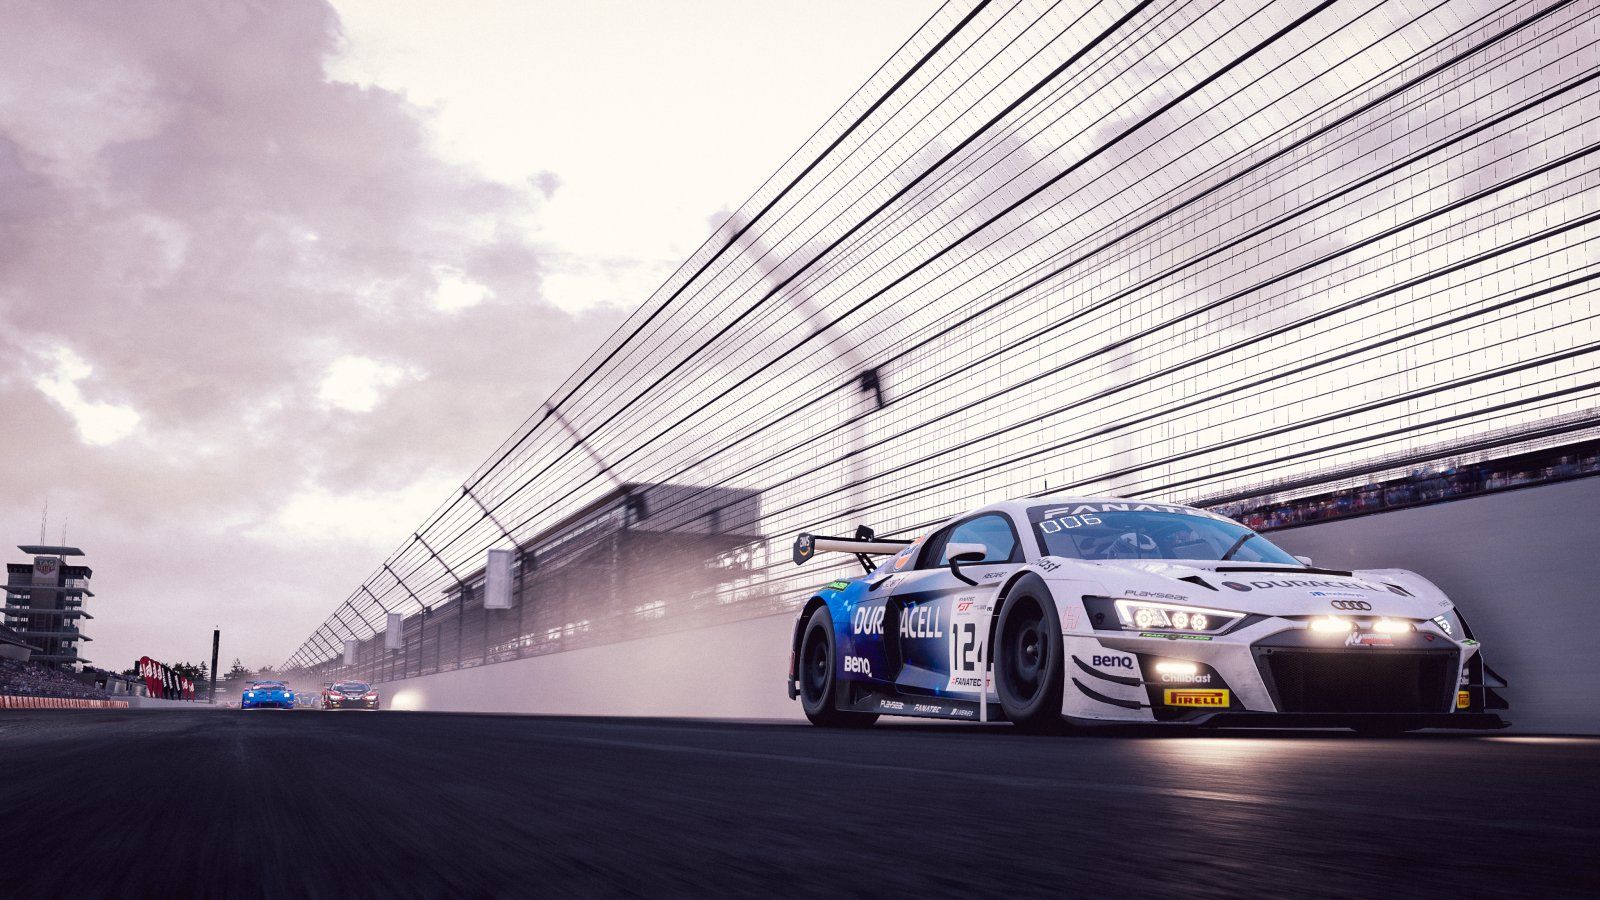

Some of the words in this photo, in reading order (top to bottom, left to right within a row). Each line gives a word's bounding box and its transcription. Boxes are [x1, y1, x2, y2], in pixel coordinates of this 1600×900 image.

[1039, 514, 1103, 534] 006
[1092, 655, 1134, 670] BenQ
[1160, 673, 1212, 684] Chillblast
[1170, 691, 1224, 705] PIRELLI
